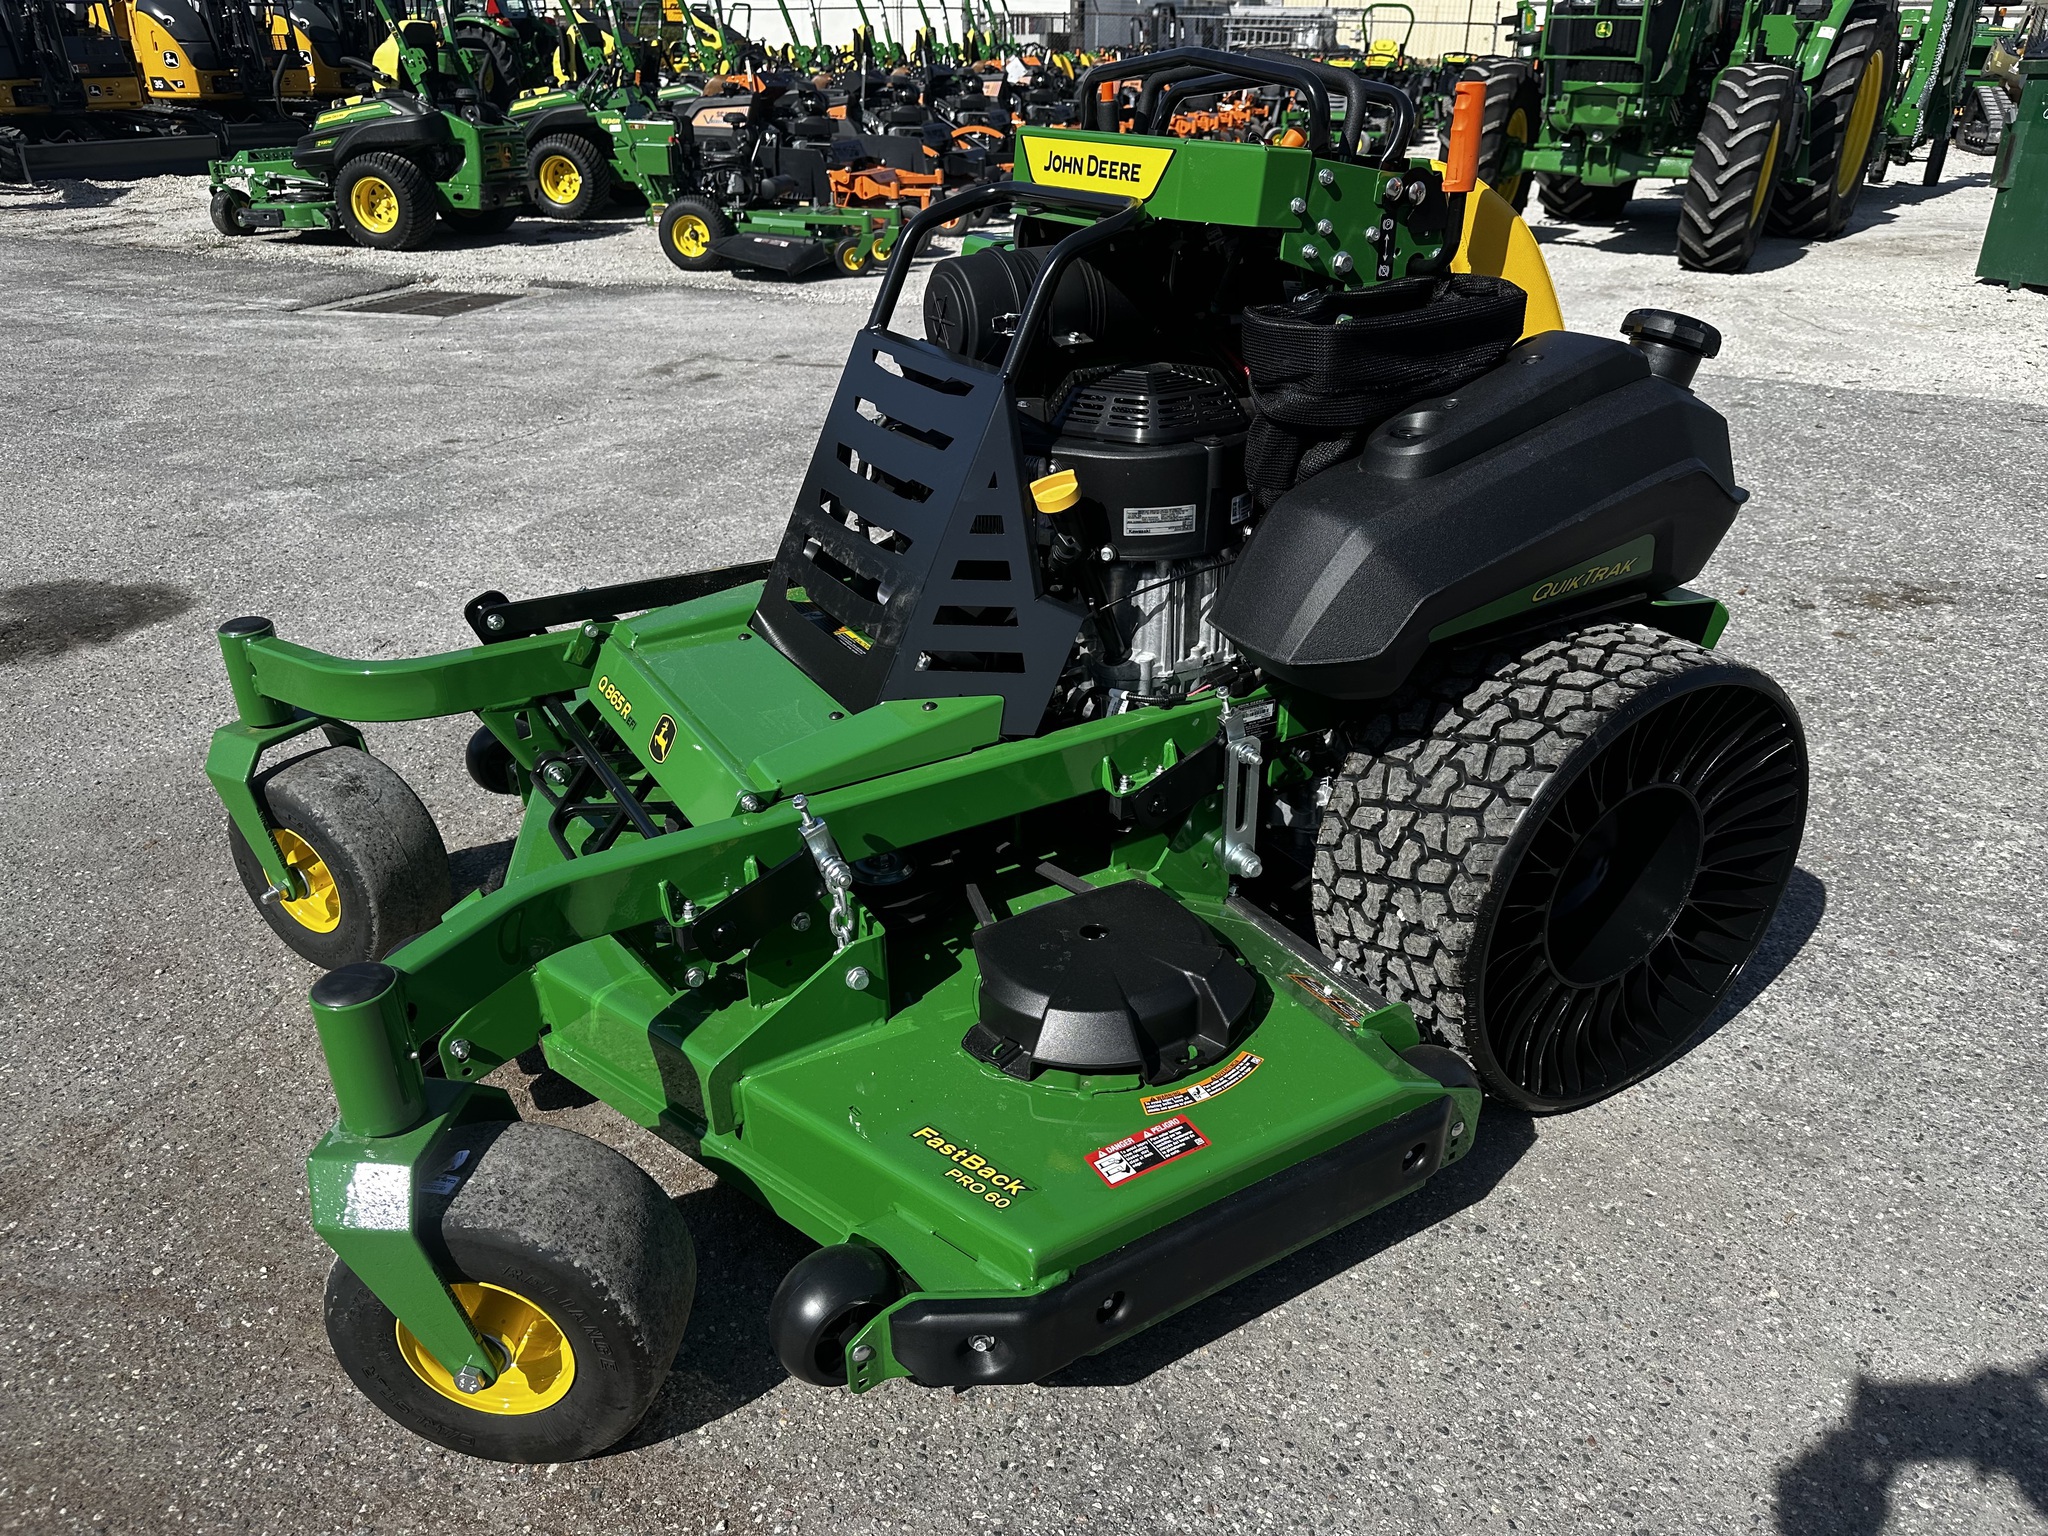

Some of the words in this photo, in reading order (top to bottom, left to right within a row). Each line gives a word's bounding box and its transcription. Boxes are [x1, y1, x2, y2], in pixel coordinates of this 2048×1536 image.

[153, 79, 164, 89] 35
[1043, 150, 1084, 176] JOHN
[1086, 154, 1142, 183] DEERE
[1150, 1117, 1180, 1134] PELIGRO
[911, 1125, 1029, 1197] FastBack
[1105, 1137, 1135, 1154] DANGER
[944, 1168, 987, 1194] PRO
[984, 1192, 1011, 1209] 60
[501, 1264, 619, 1373] RELIANCE
